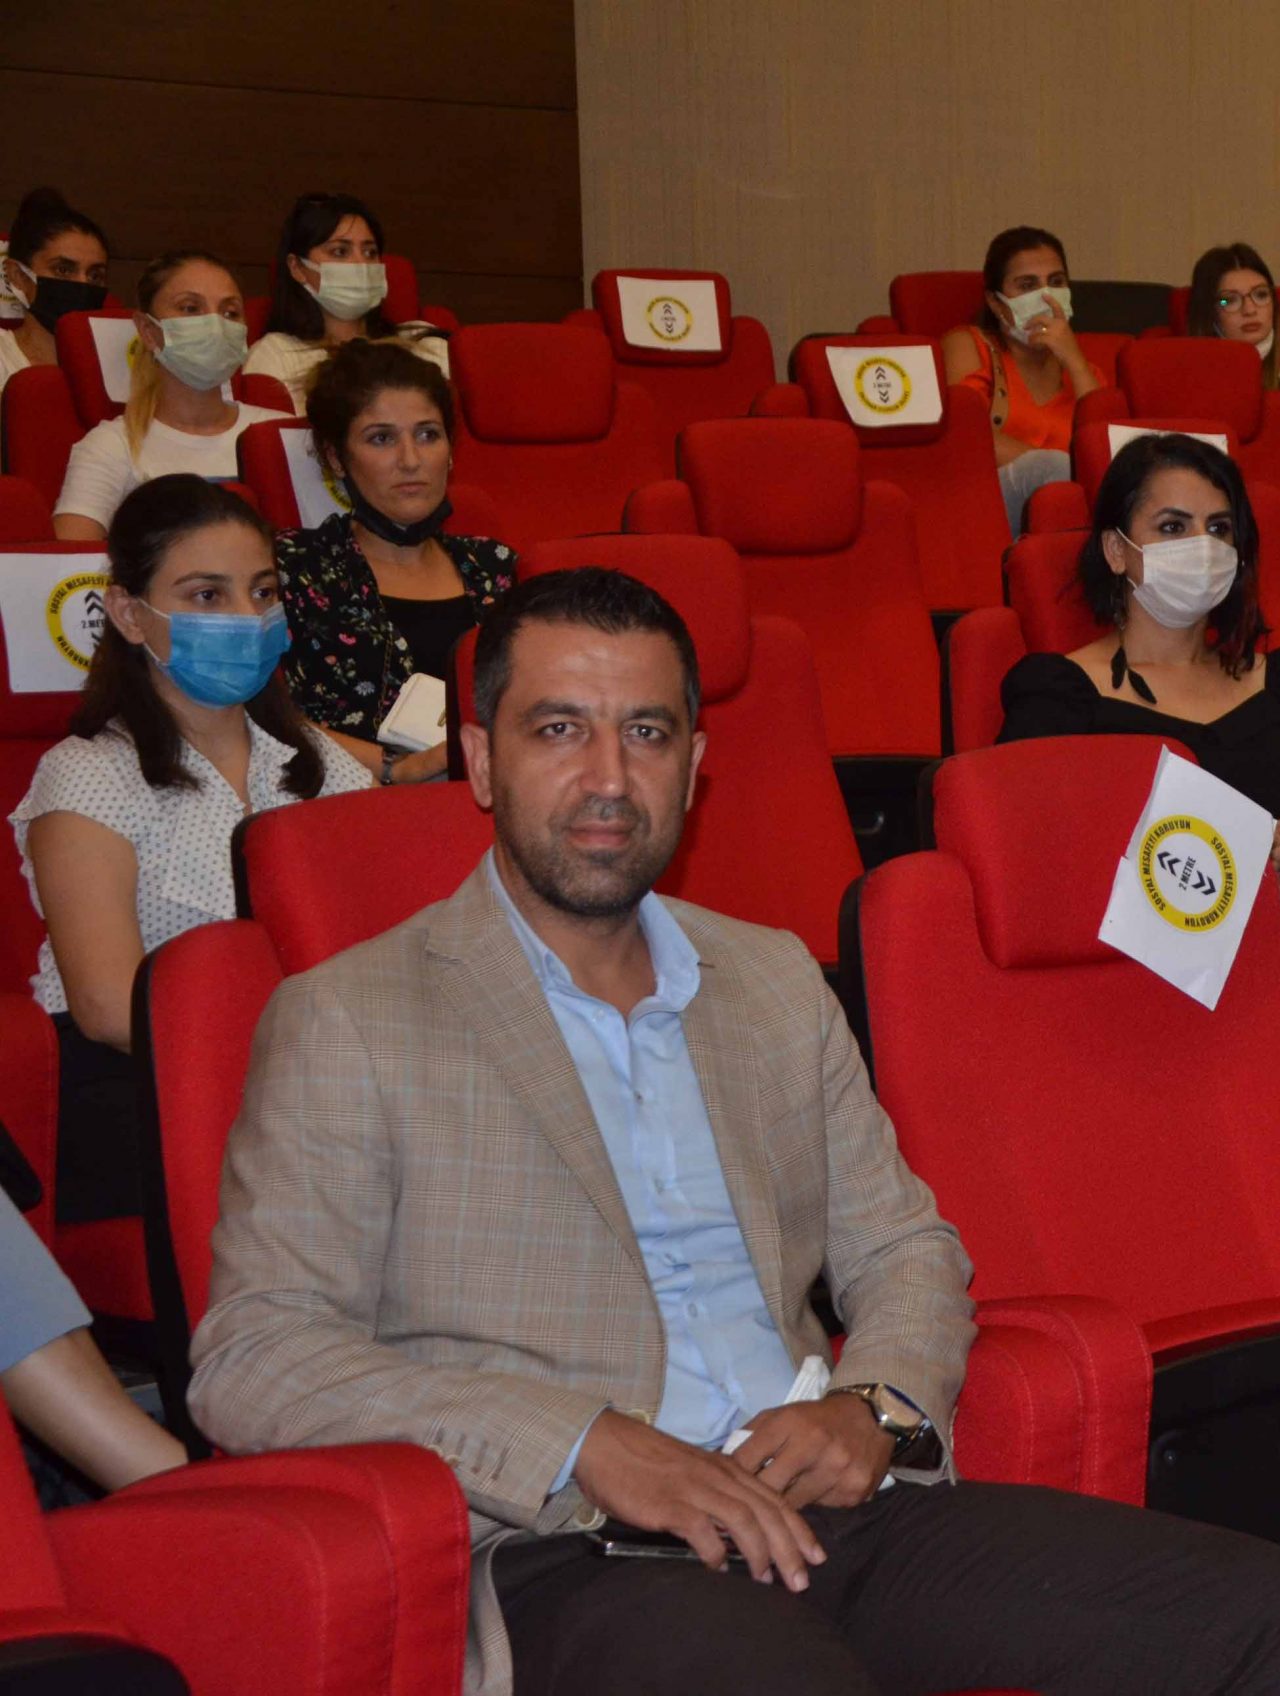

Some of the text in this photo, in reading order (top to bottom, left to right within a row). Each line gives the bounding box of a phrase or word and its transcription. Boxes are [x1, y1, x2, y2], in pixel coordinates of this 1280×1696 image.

[88, 619, 105, 628] MET
[1154, 819, 1191, 838] KORUYUN
[1211, 836, 1231, 870] SOSYAL
[1178, 856, 1196, 891] 2 METRE
[1145, 877, 1165, 911] SOSYAL
[1185, 909, 1220, 928] KORUYUN
